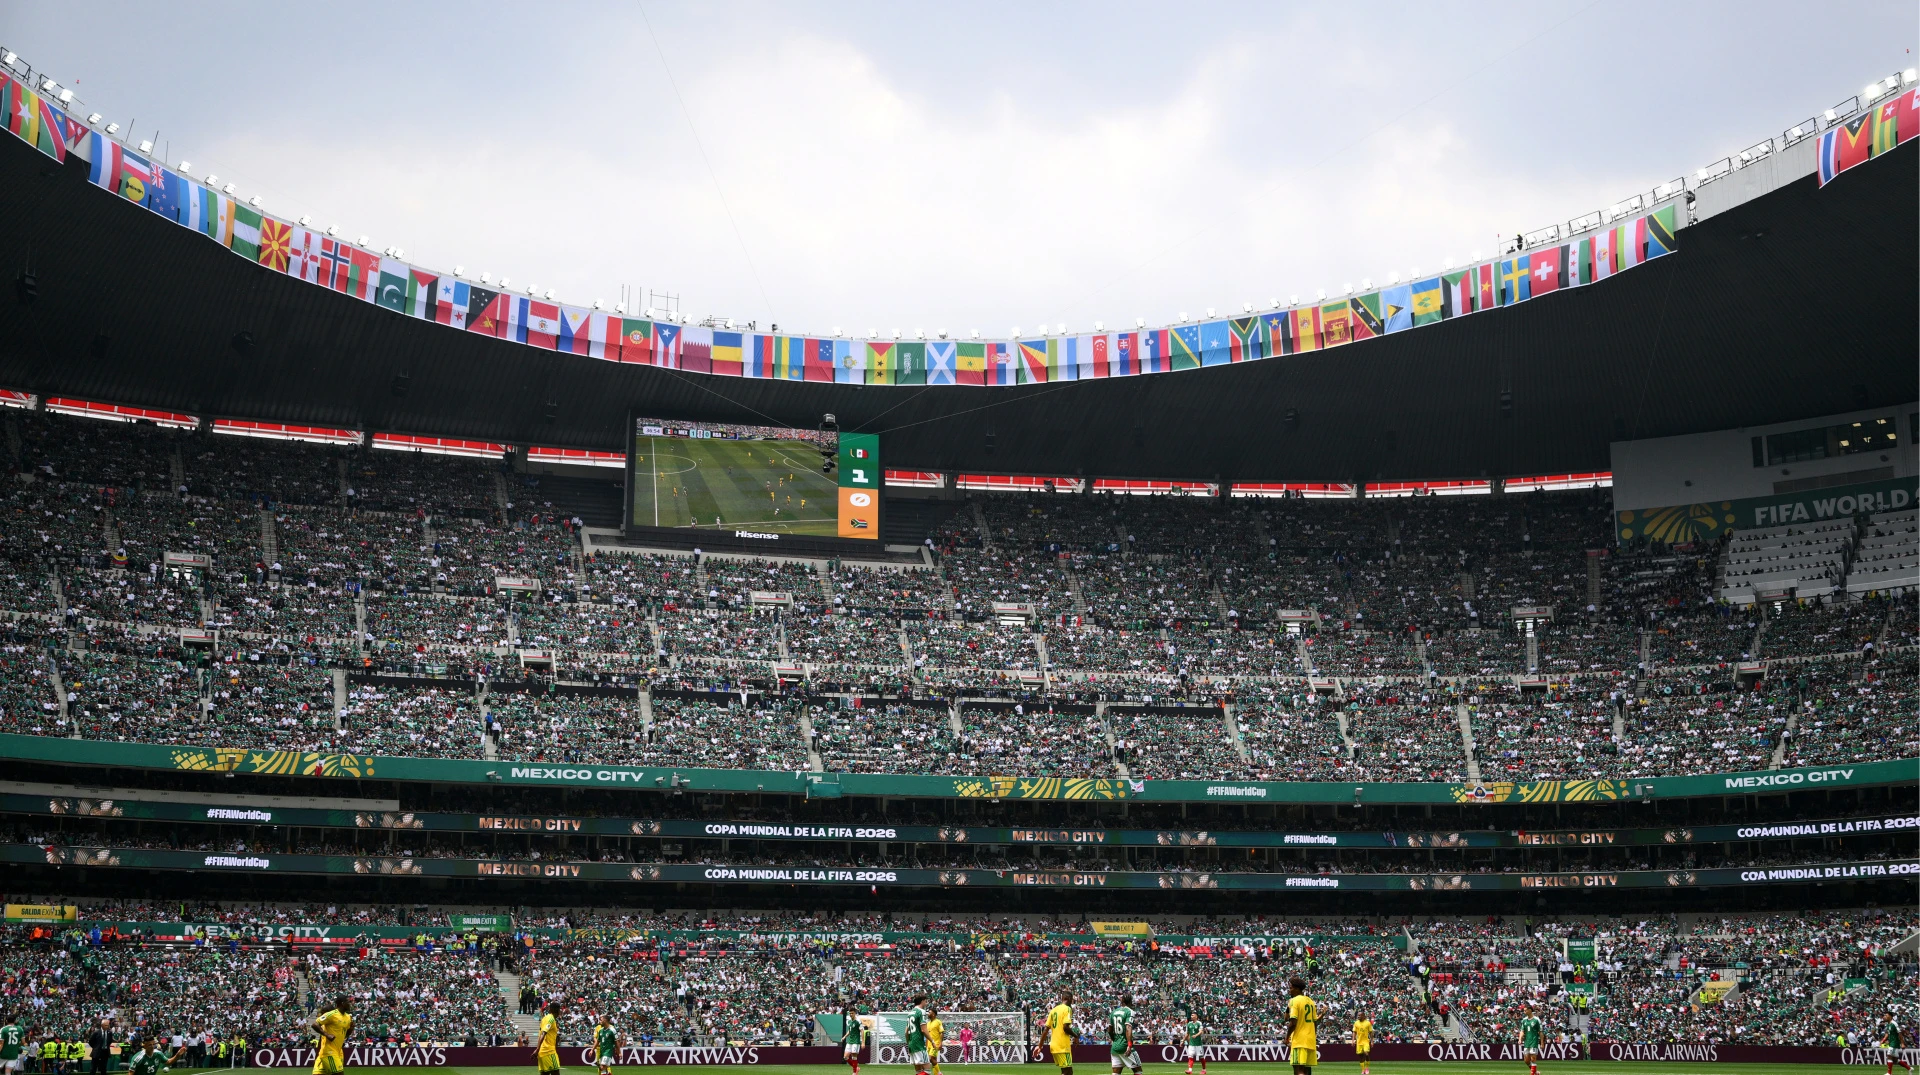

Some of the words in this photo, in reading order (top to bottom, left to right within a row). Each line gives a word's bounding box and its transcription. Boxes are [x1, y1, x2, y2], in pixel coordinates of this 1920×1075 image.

[852, 469, 869, 484] 1
[849, 492, 871, 507] 0
[1754, 502, 1811, 526] FIFA
[1812, 489, 1909, 518] WORLD
[735, 530, 779, 540] Hisense
[511, 767, 592, 780] MEXICO
[596, 770, 644, 782] CITY
[1725, 773, 1804, 788] MEXICO
[1808, 769, 1854, 782] CITY
[1206, 786, 1266, 797] #FIFAWorldCup
[207, 808, 271, 822] #FIFAWorldCup
[479, 817, 541, 830] MEXICO
[545, 819, 581, 831] CITY
[705, 824, 737, 835] COPA
[739, 825, 792, 836] MUNDIAL
[794, 827, 809, 837] DE
[811, 827, 826, 837] LA
[828, 827, 853, 838] FIFA
[855, 828, 897, 838] 2026
[1820, 823, 1837, 833] DE
[1838, 822, 1854, 832] LA
[1856, 820, 1882, 831] FIFA
[1012, 830, 1069, 842] MEXICO
[1072, 831, 1105, 842] CITY
[1284, 834, 1337, 845] #FIFAWorldCup
[1518, 833, 1577, 845] MEXICO
[1580, 832, 1615, 844] CITY
[204, 855, 269, 869] #FIFAWorldCup
[478, 863, 541, 875] MEXICO
[544, 864, 581, 877] CITY
[705, 868, 737, 879] COPA
[739, 869, 792, 880] MUNDIAL
[794, 870, 809, 880] DE
[811, 870, 826, 881] LA
[828, 870, 853, 881] FIFA
[856, 871, 897, 882] 2026
[1768, 868, 1823, 880] MUNDIAL
[1824, 867, 1841, 878] DE
[1842, 866, 1858, 877] LA
[1860, 865, 1887, 876] FIFA
[1013, 873, 1070, 885] MEXICO
[1073, 874, 1107, 885] CITY
[1286, 877, 1338, 888] #FIFAWorldCup
[1520, 875, 1580, 887] MEXICO
[1583, 875, 1618, 886] CITY
[21, 907, 41, 915] SALIDA
[463, 917, 481, 925] SALIDA
[185, 925, 273, 937] MEXCO
[278, 926, 330, 938] CITY
[1304, 1004, 1314, 1023] 21
[1113, 1016, 1123, 1035] 16
[8, 1031, 19, 1045] 15
[255, 1048, 316, 1068] QATA
[346, 1048, 447, 1066] AIRWAYS
[581, 1047, 657, 1066] QTAR
[666, 1047, 759, 1065] AIRWAYS
[879, 1046, 949, 1063] QAR
[1428, 1043, 1496, 1061] QATAR
[1609, 1044, 1659, 1061] QATAR
[1664, 1044, 1718, 1061] AIRWAYS
